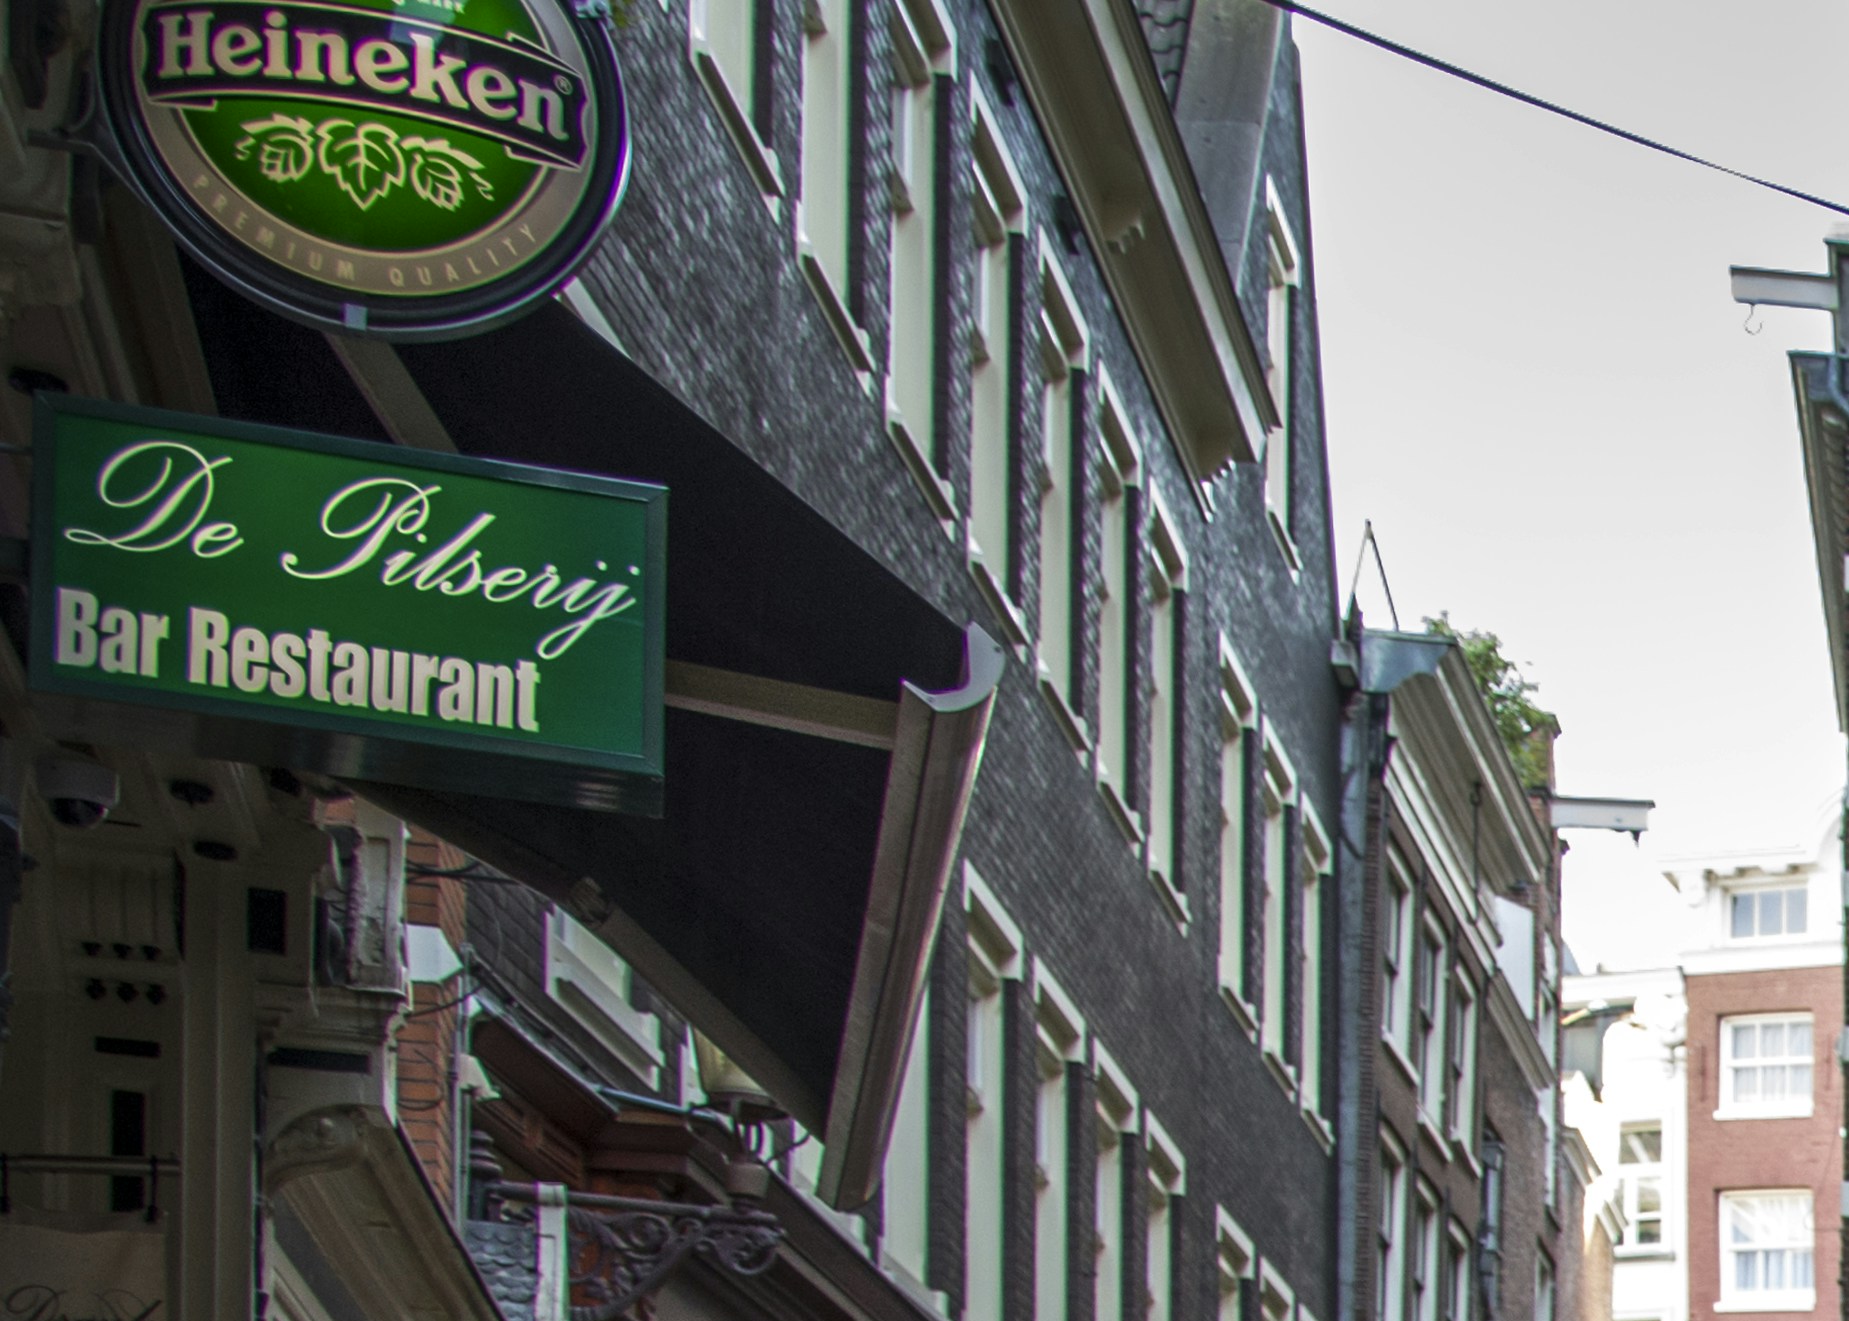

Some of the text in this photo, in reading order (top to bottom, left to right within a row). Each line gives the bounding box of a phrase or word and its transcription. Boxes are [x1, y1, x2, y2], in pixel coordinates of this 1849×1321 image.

[155, 10, 570, 141] Heineken
[192, 176, 538, 288] PREMIUM QUALITY
[64, 440, 641, 661] De Pilserij
[55, 586, 541, 733] Bar Restaurant
